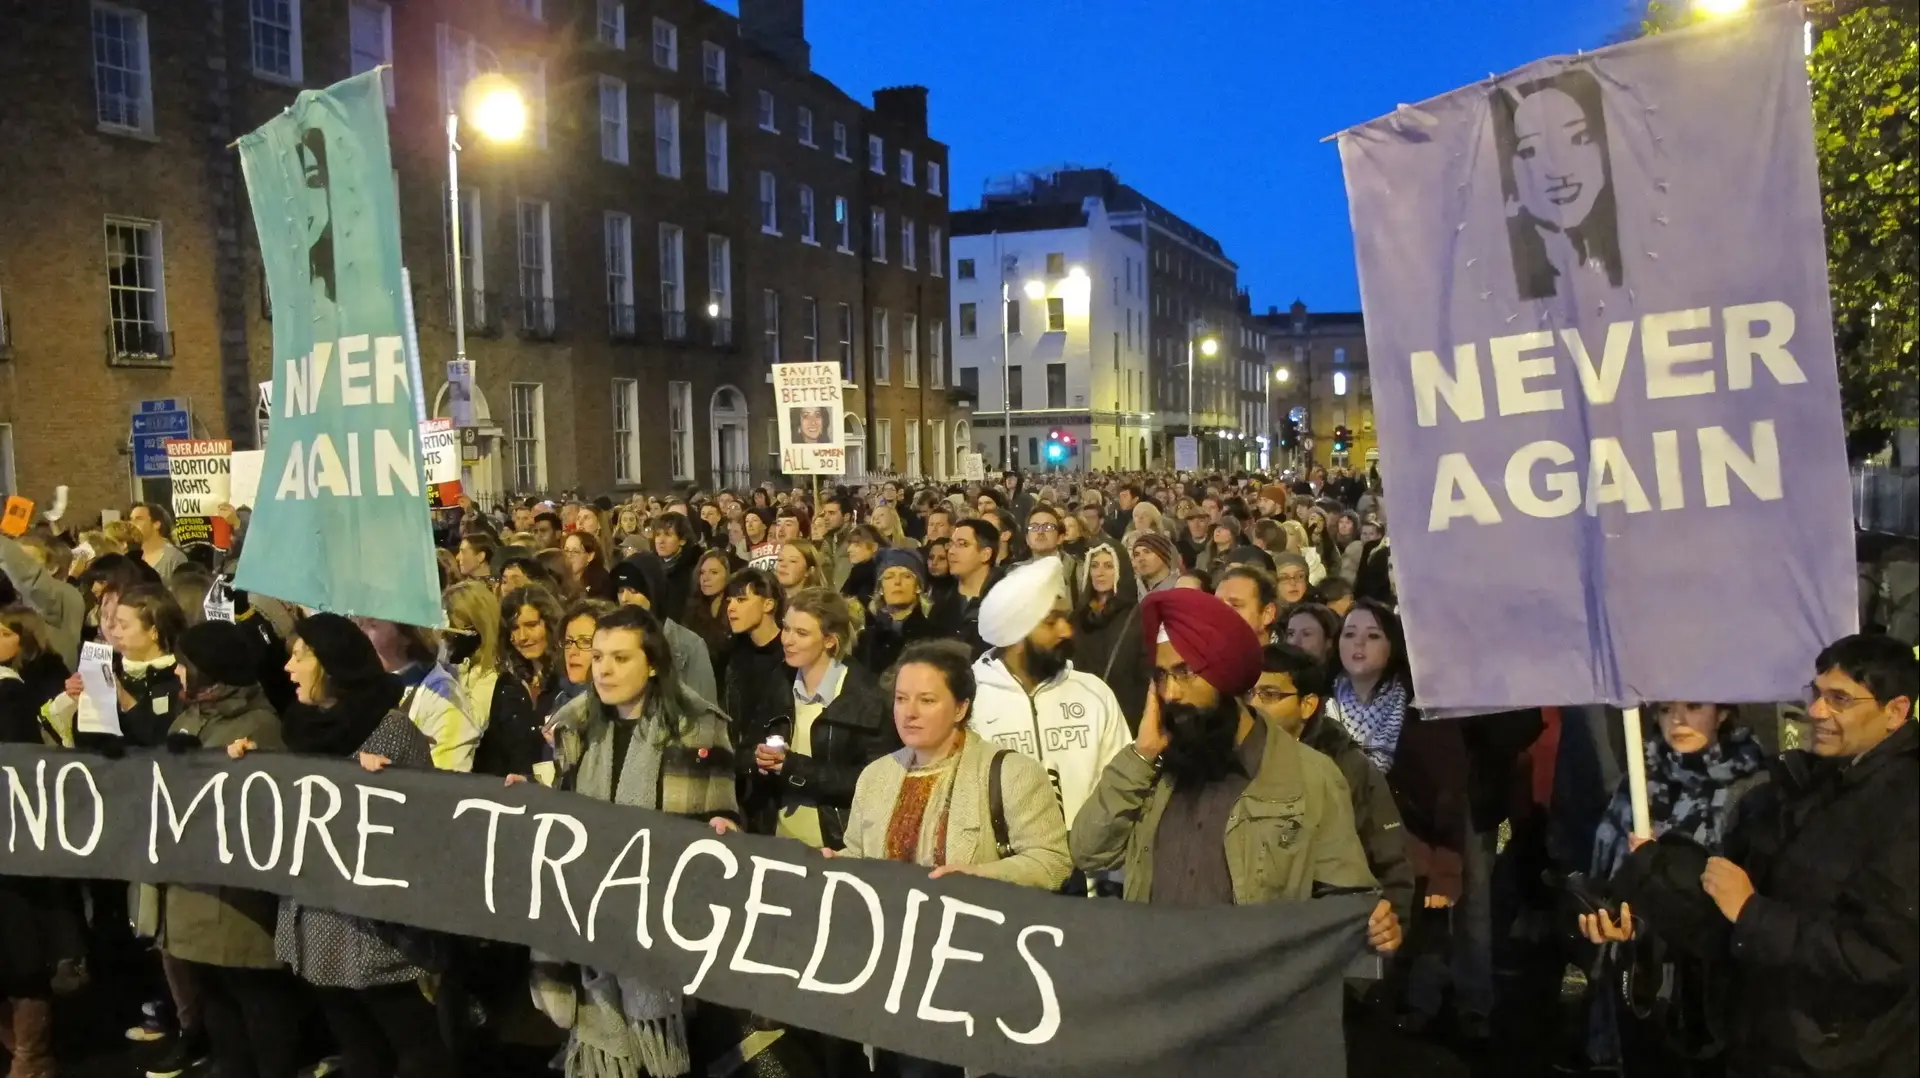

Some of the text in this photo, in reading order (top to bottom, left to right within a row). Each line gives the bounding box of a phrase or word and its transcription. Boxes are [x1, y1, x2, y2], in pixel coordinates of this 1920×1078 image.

[449, 362, 469, 375] YES
[780, 366, 833, 377] SAVITA
[1410, 301, 1808, 427] NEVER
[284, 334, 411, 418] NVER
[783, 377, 833, 386] DESERVED
[782, 386, 839, 403] BETTER
[167, 441, 228, 456] NEVER AGAIN
[170, 458, 231, 475] ABORTION
[783, 448, 844, 472] ALL WOMEN
[820, 459, 839, 471] DO!
[1427, 419, 1784, 532] AGAIN
[173, 479, 211, 495] RIGHTS
[175, 498, 200, 514] NOW
[178, 532, 208, 541] HEALTH
[1060, 702, 1085, 719] 10
[1045, 725, 1090, 751] DPT
[2, 759, 1065, 1046] NO MORE TRAGEDIES
